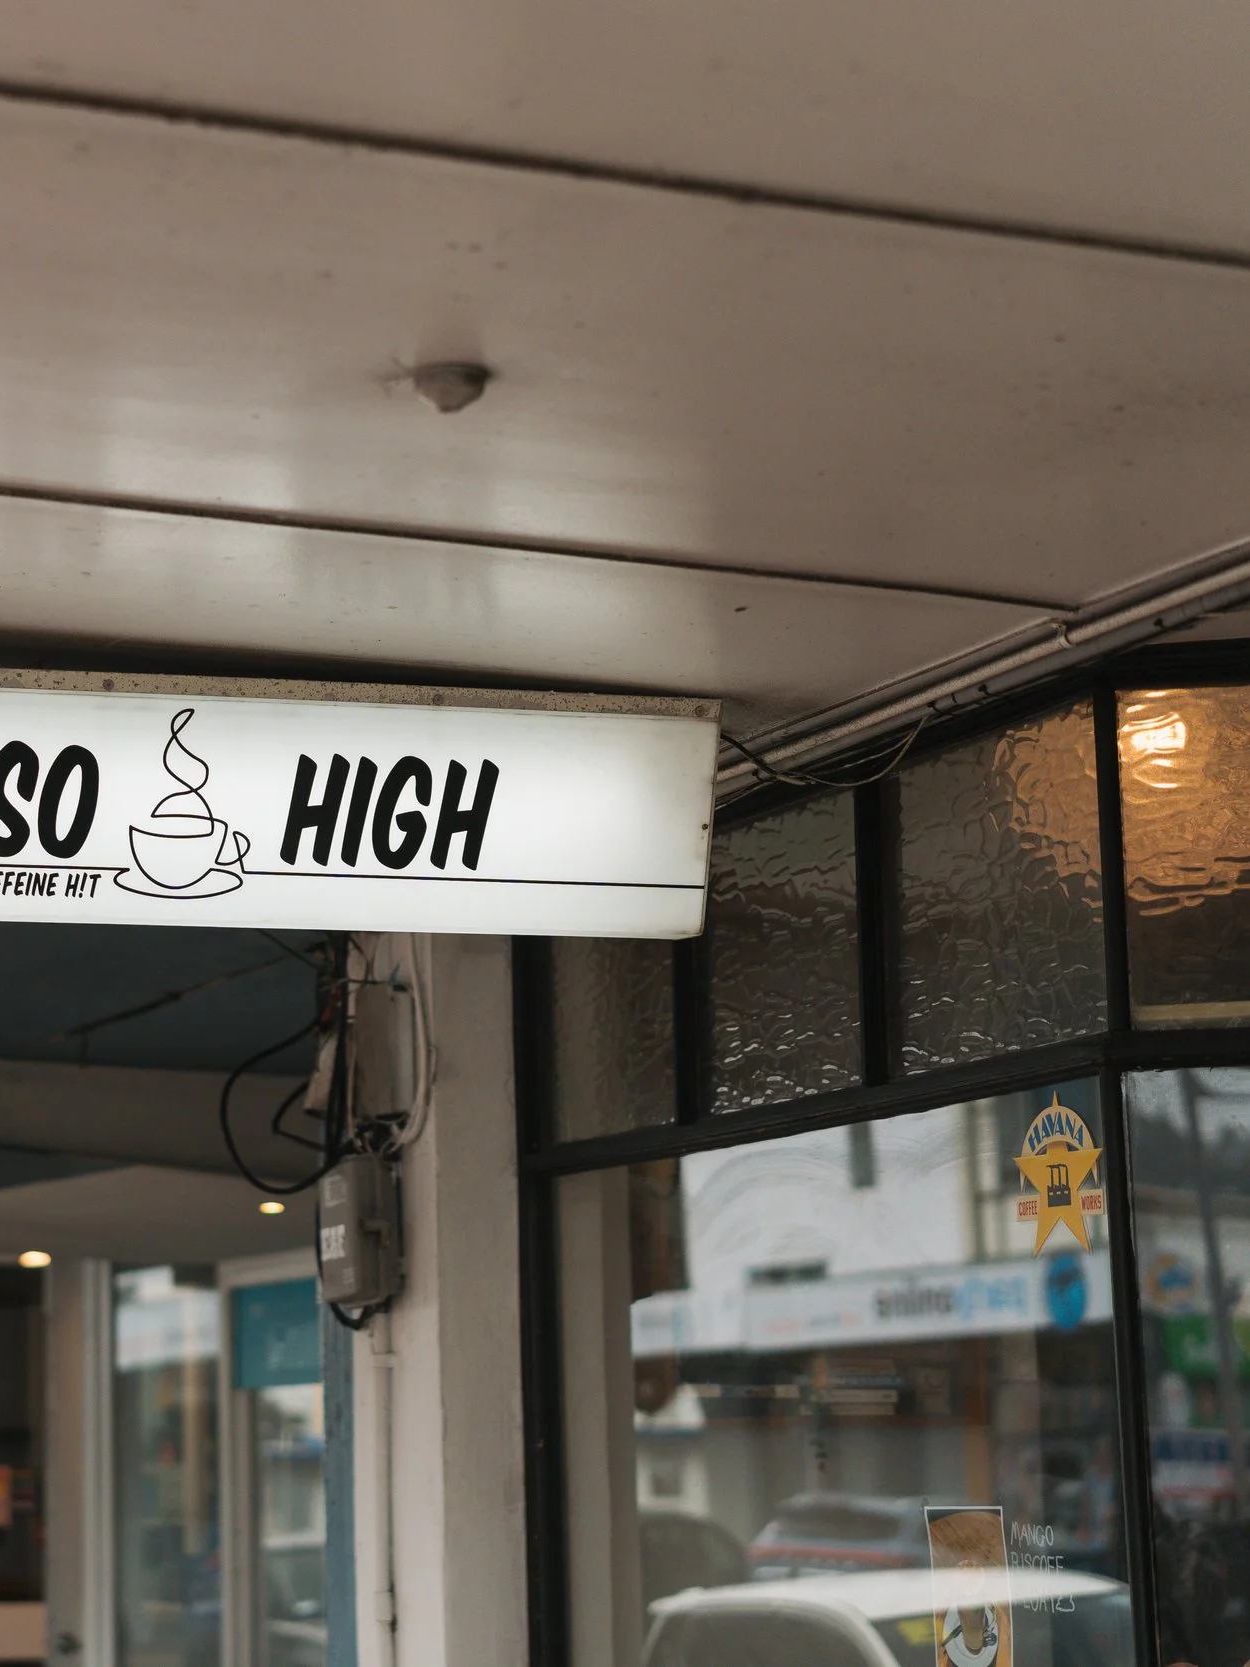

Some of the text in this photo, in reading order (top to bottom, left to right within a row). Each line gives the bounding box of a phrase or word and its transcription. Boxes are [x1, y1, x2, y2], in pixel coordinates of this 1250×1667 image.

[279, 753, 500, 871] HIGH
[1027, 1111, 1085, 1153] HAVANA
[1018, 1195, 1102, 1217] COFFEE WORKS
[1010, 1520, 1054, 1549] MANGO
